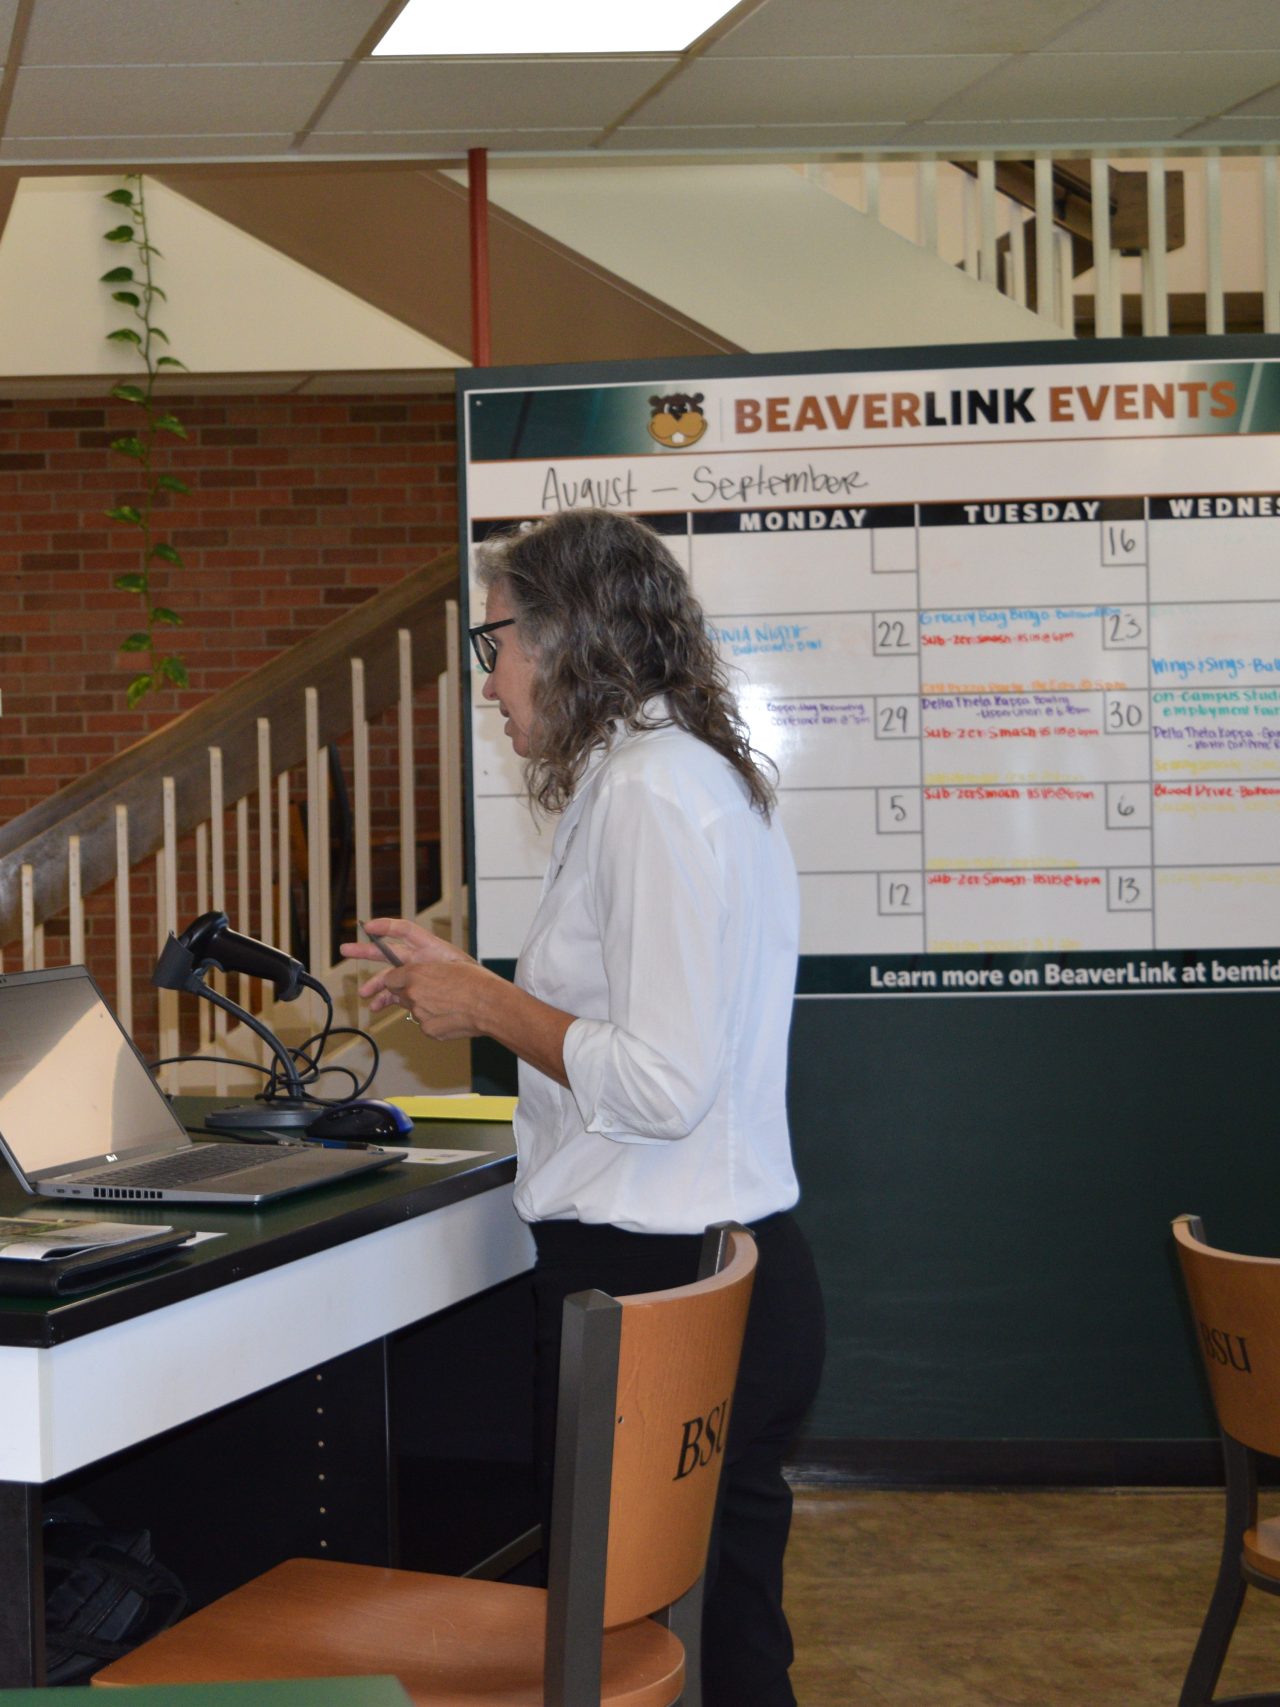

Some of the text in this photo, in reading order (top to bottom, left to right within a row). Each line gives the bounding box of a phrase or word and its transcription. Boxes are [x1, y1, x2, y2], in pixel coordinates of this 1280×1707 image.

[735, 381, 1238, 434] BEAVERLINK EVENTS
[541, 466, 638, 511] August
[690, 465, 868, 504] September
[739, 509, 868, 532] MONDAY
[964, 501, 1101, 524] TUESDAY
[1109, 527, 1136, 556] 16
[878, 620, 910, 647] 22
[1110, 613, 1142, 642] 23
[880, 706, 909, 733] 29
[1109, 701, 1142, 729] 30
[890, 795, 907, 822] 5
[1116, 794, 1135, 817] 6
[888, 882, 911, 907] 12
[1118, 876, 1141, 904] 13
[869, 966, 936, 987] Learn
[942, 967, 1003, 986] more
[1008, 967, 1038, 985] on
[1044, 962, 1176, 985] BeaverLink
[1181, 961, 1206, 983] at
